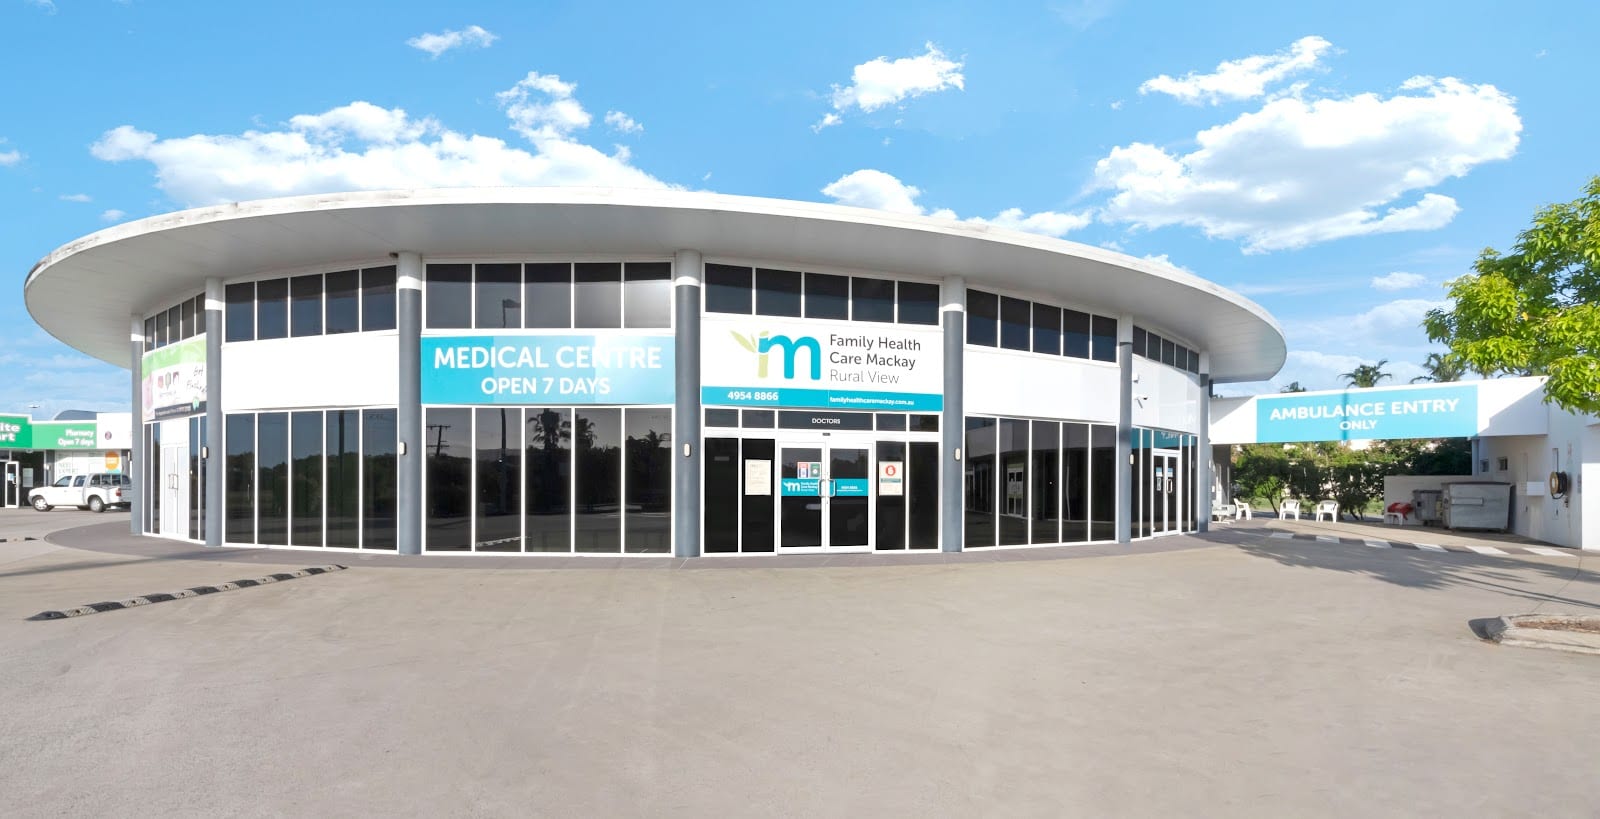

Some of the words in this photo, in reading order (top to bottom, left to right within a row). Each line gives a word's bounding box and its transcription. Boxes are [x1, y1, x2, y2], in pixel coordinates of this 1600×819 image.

[829, 333, 874, 351] Family
[878, 336, 921, 351] Health
[434, 346, 549, 369] MEDICAL
[555, 346, 662, 369] CENTRE
[829, 351, 862, 365] Care
[866, 353, 916, 371] Mackay
[829, 369, 864, 383] Rural
[867, 370, 900, 384] View
[481, 377, 537, 395] OPEN
[542, 377, 552, 394] 7
[559, 377, 611, 395] DAYS
[727, 391, 752, 401] 4954
[754, 391, 779, 401] 8866
[1269, 401, 1385, 421] AMBULANCE
[1391, 397, 1460, 416] ENTRY
[812, 417, 841, 425] DOCTORS
[1339, 419, 1378, 431] ONLY
